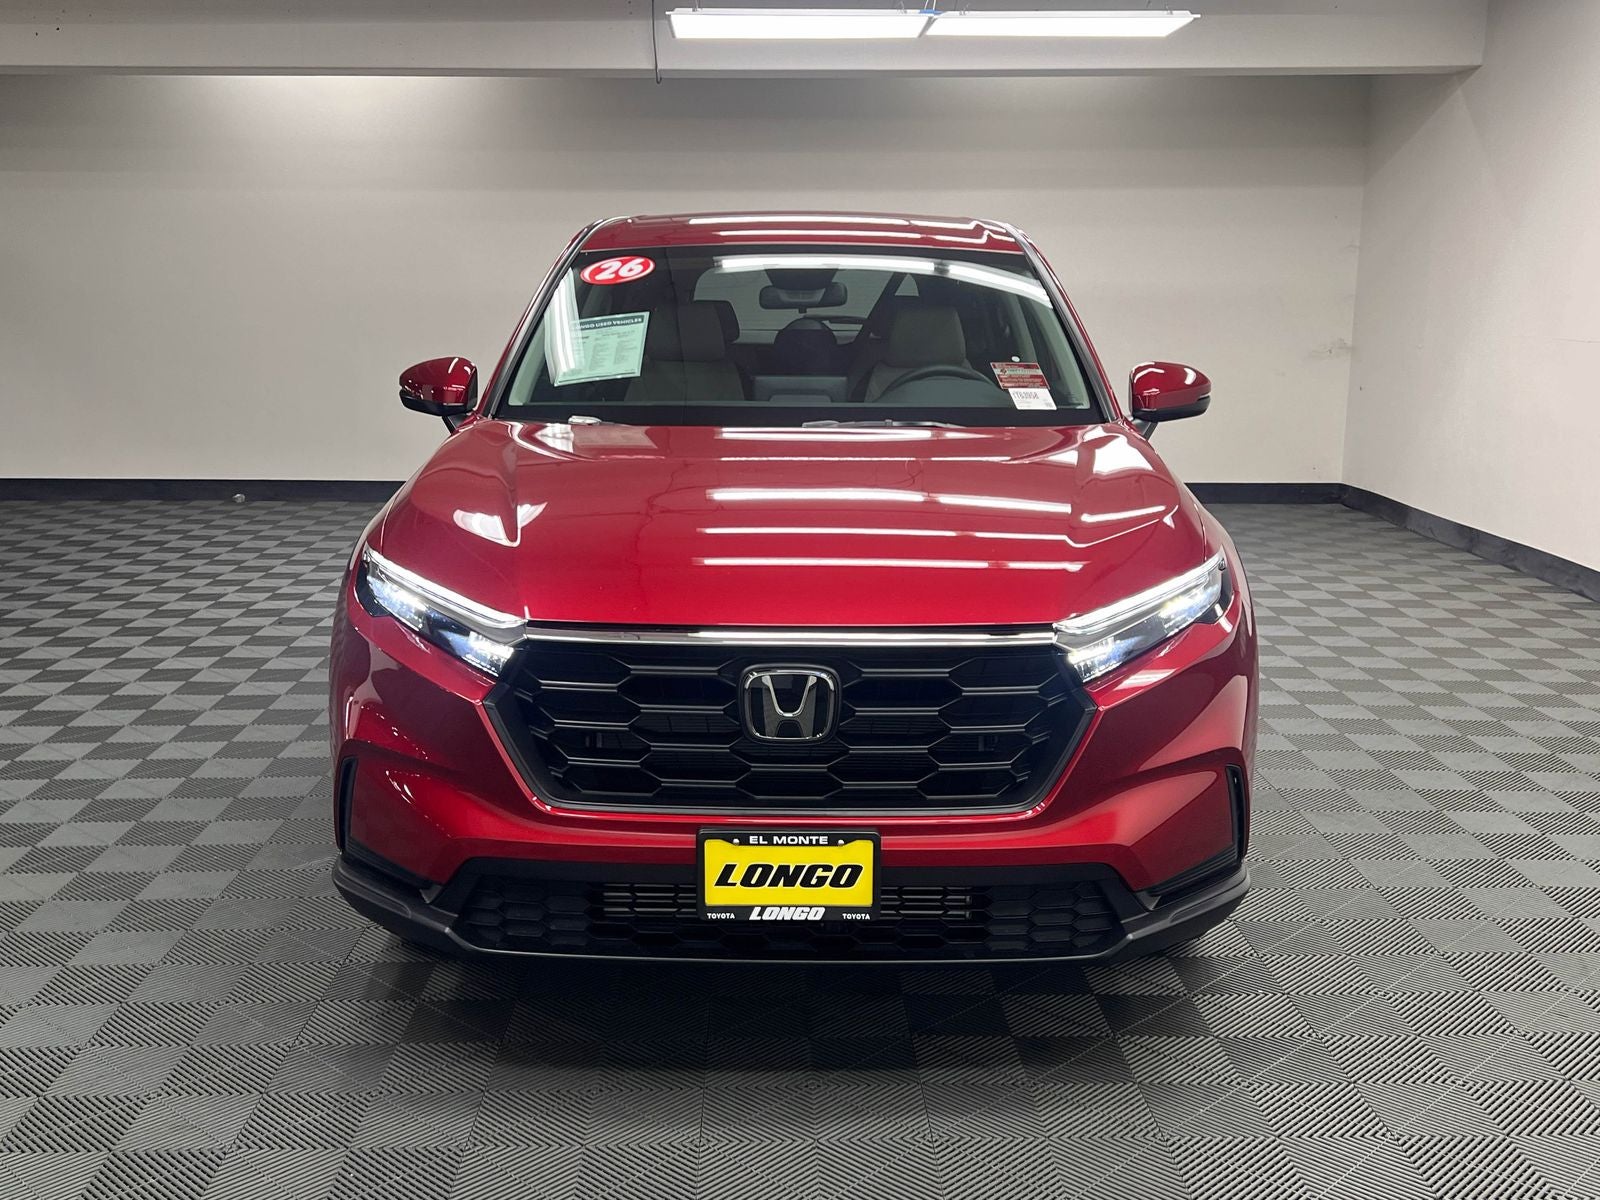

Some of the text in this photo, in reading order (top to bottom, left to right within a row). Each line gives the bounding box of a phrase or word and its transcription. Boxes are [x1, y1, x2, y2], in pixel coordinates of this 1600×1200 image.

[594, 258, 645, 280] 26
[596, 320, 613, 328] USED
[613, 317, 643, 326] VEHICLES
[749, 835, 829, 845] EL MONTE
[714, 863, 864, 888] LONGO
[707, 912, 736, 920] TOYOTA
[749, 906, 826, 921] LONGO
[842, 912, 871, 920] TOYOTA
